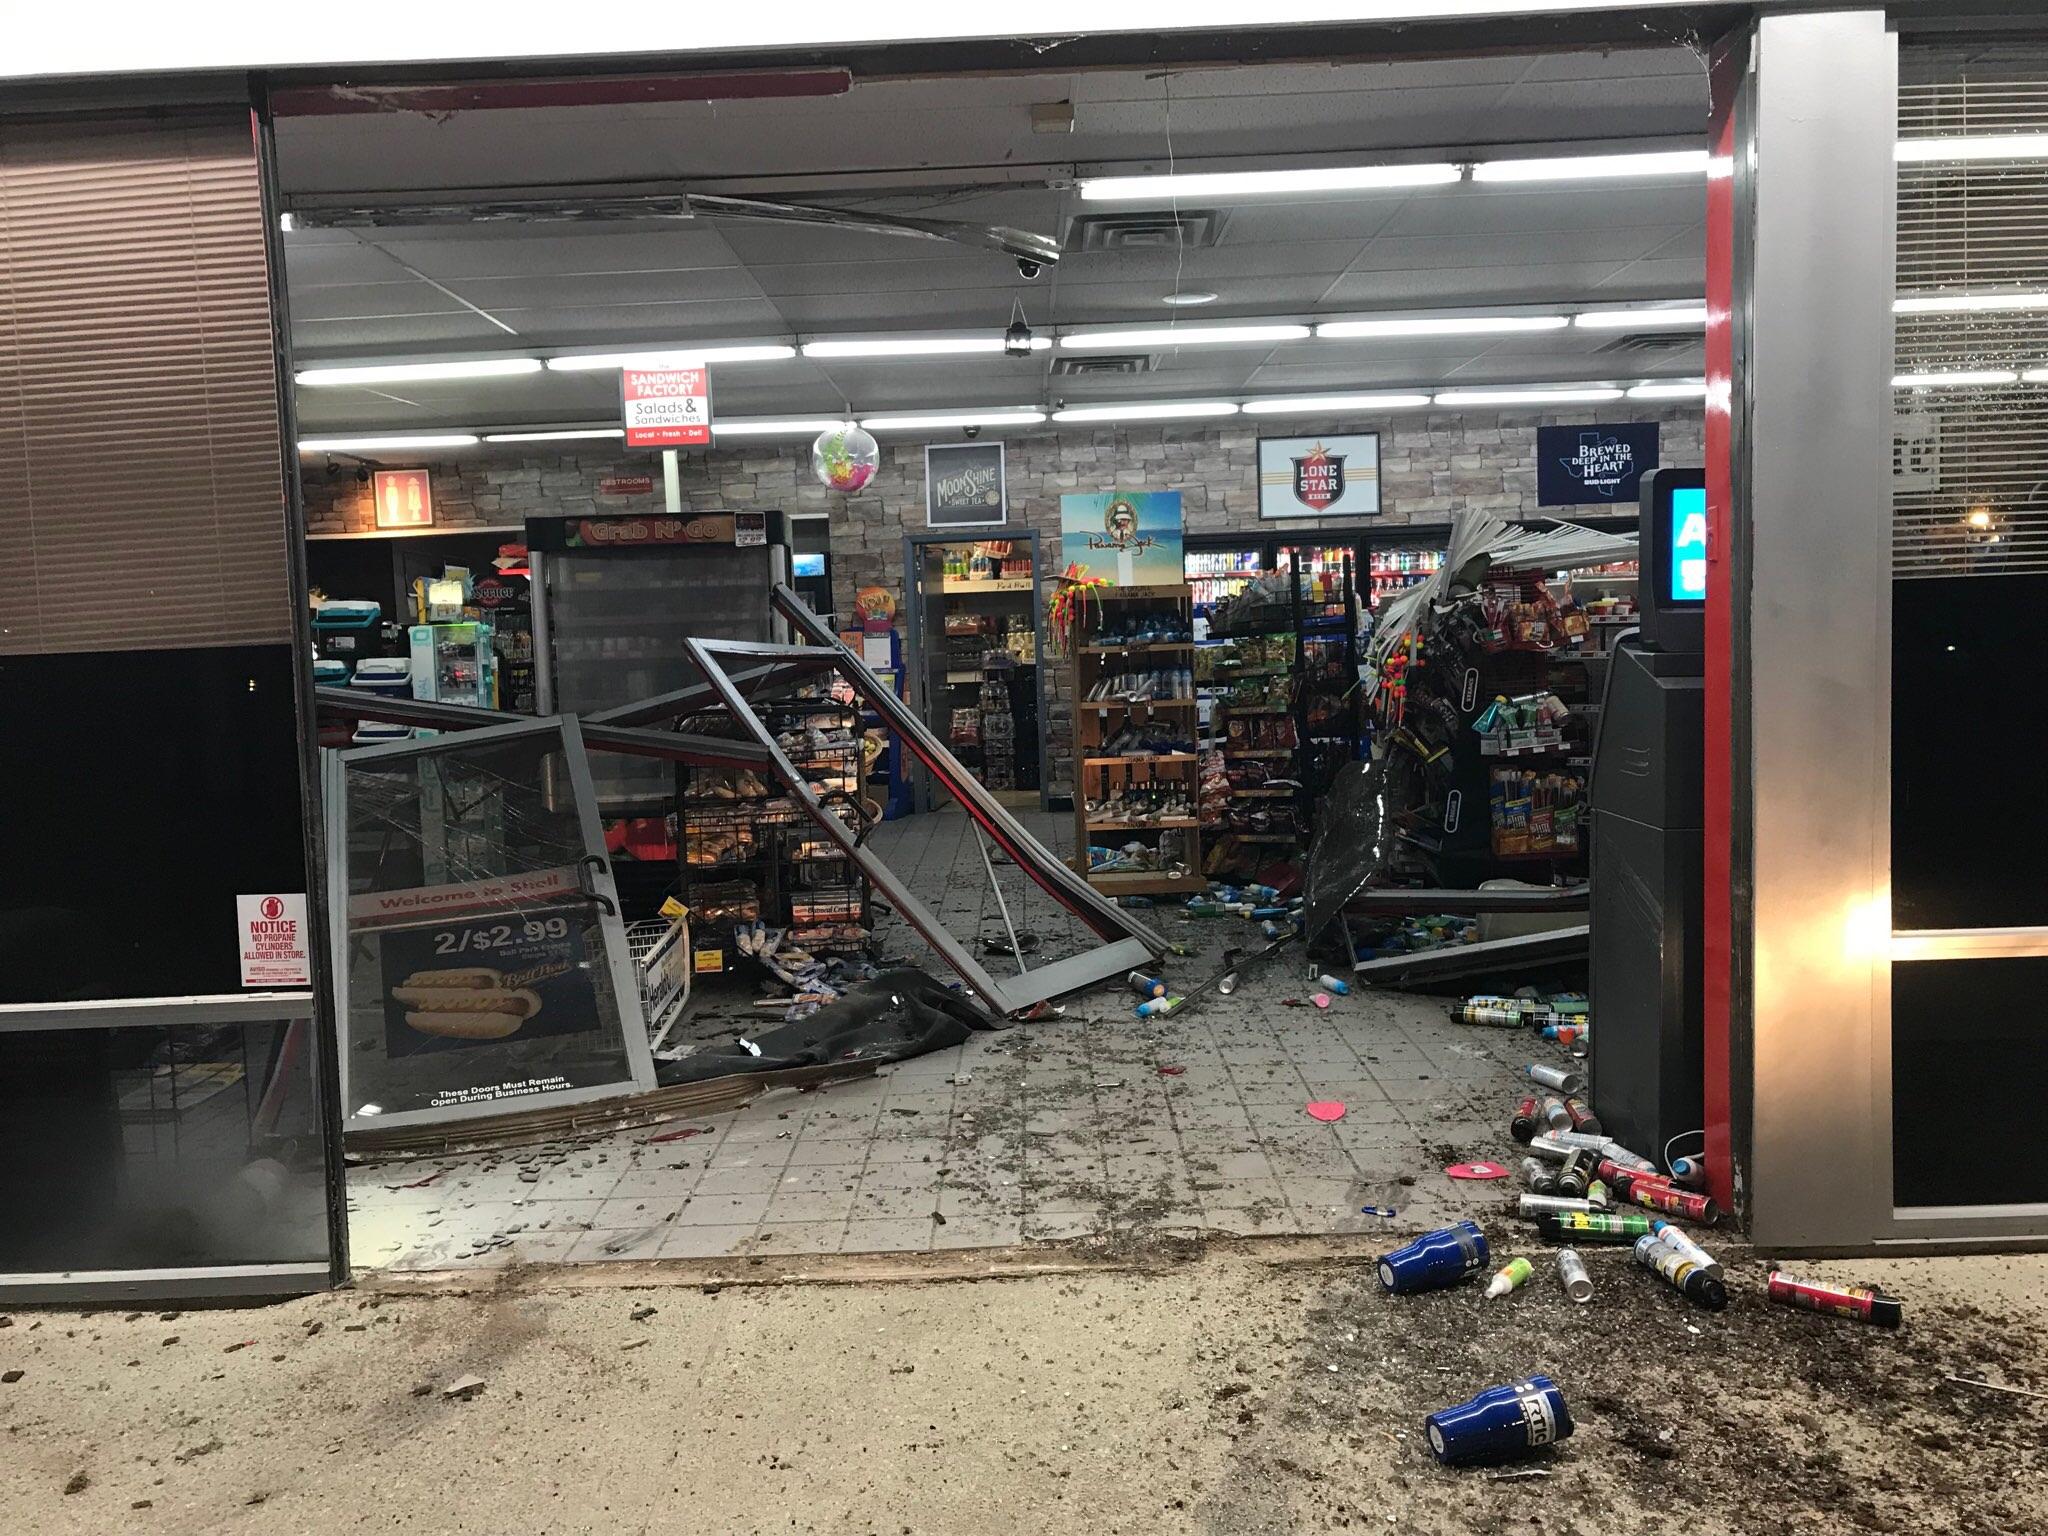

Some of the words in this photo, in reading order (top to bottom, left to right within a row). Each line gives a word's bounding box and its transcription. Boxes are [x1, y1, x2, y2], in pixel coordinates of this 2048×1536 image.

[630, 372, 699, 386] SANDWICH
[637, 384, 694, 396] FACTORY
[636, 402, 683, 415] Salads
[685, 398, 697, 413] &
[635, 415, 701, 425] Sandwiches
[662, 430, 681, 438] Fresh
[1579, 444, 1631, 458] BREWED
[1572, 457, 1597, 465] DEEP
[1600, 454, 1610, 463] IN
[1300, 465, 1337, 477] LONE
[1584, 461, 1624, 477] HEART
[600, 478, 650, 486] RESTROOMS
[1300, 479, 1338, 491] STAR
[971, 497, 982, 505] TEA
[591, 521, 648, 540] Grab
[686, 521, 719, 538] Go
[380, 890, 476, 909] Welcome
[484, 887, 503, 897] to
[510, 875, 559, 893] Shell
[250, 921, 296, 933] NOTICE
[252, 934, 262, 942] NO
[264, 933, 296, 942] PROPANE
[434, 917, 568, 954] 2/$2.99
[256, 942, 293, 951] CYLINDERS
[244, 951, 274, 960] ALLOWED
[275, 951, 283, 959] IN
[283, 950, 306, 959] STORE.
[439, 1089, 469, 1099] These
[471, 1085, 500, 1094] Doors
[502, 1080, 526, 1090] Must
[528, 1076, 564, 1086] Remain
[430, 1097, 457, 1107] Open
[460, 1093, 493, 1103] During
[495, 1087, 540, 1098] Business
[542, 1082, 574, 1091] Hours.
[1526, 1399, 1548, 1443] RTIC
